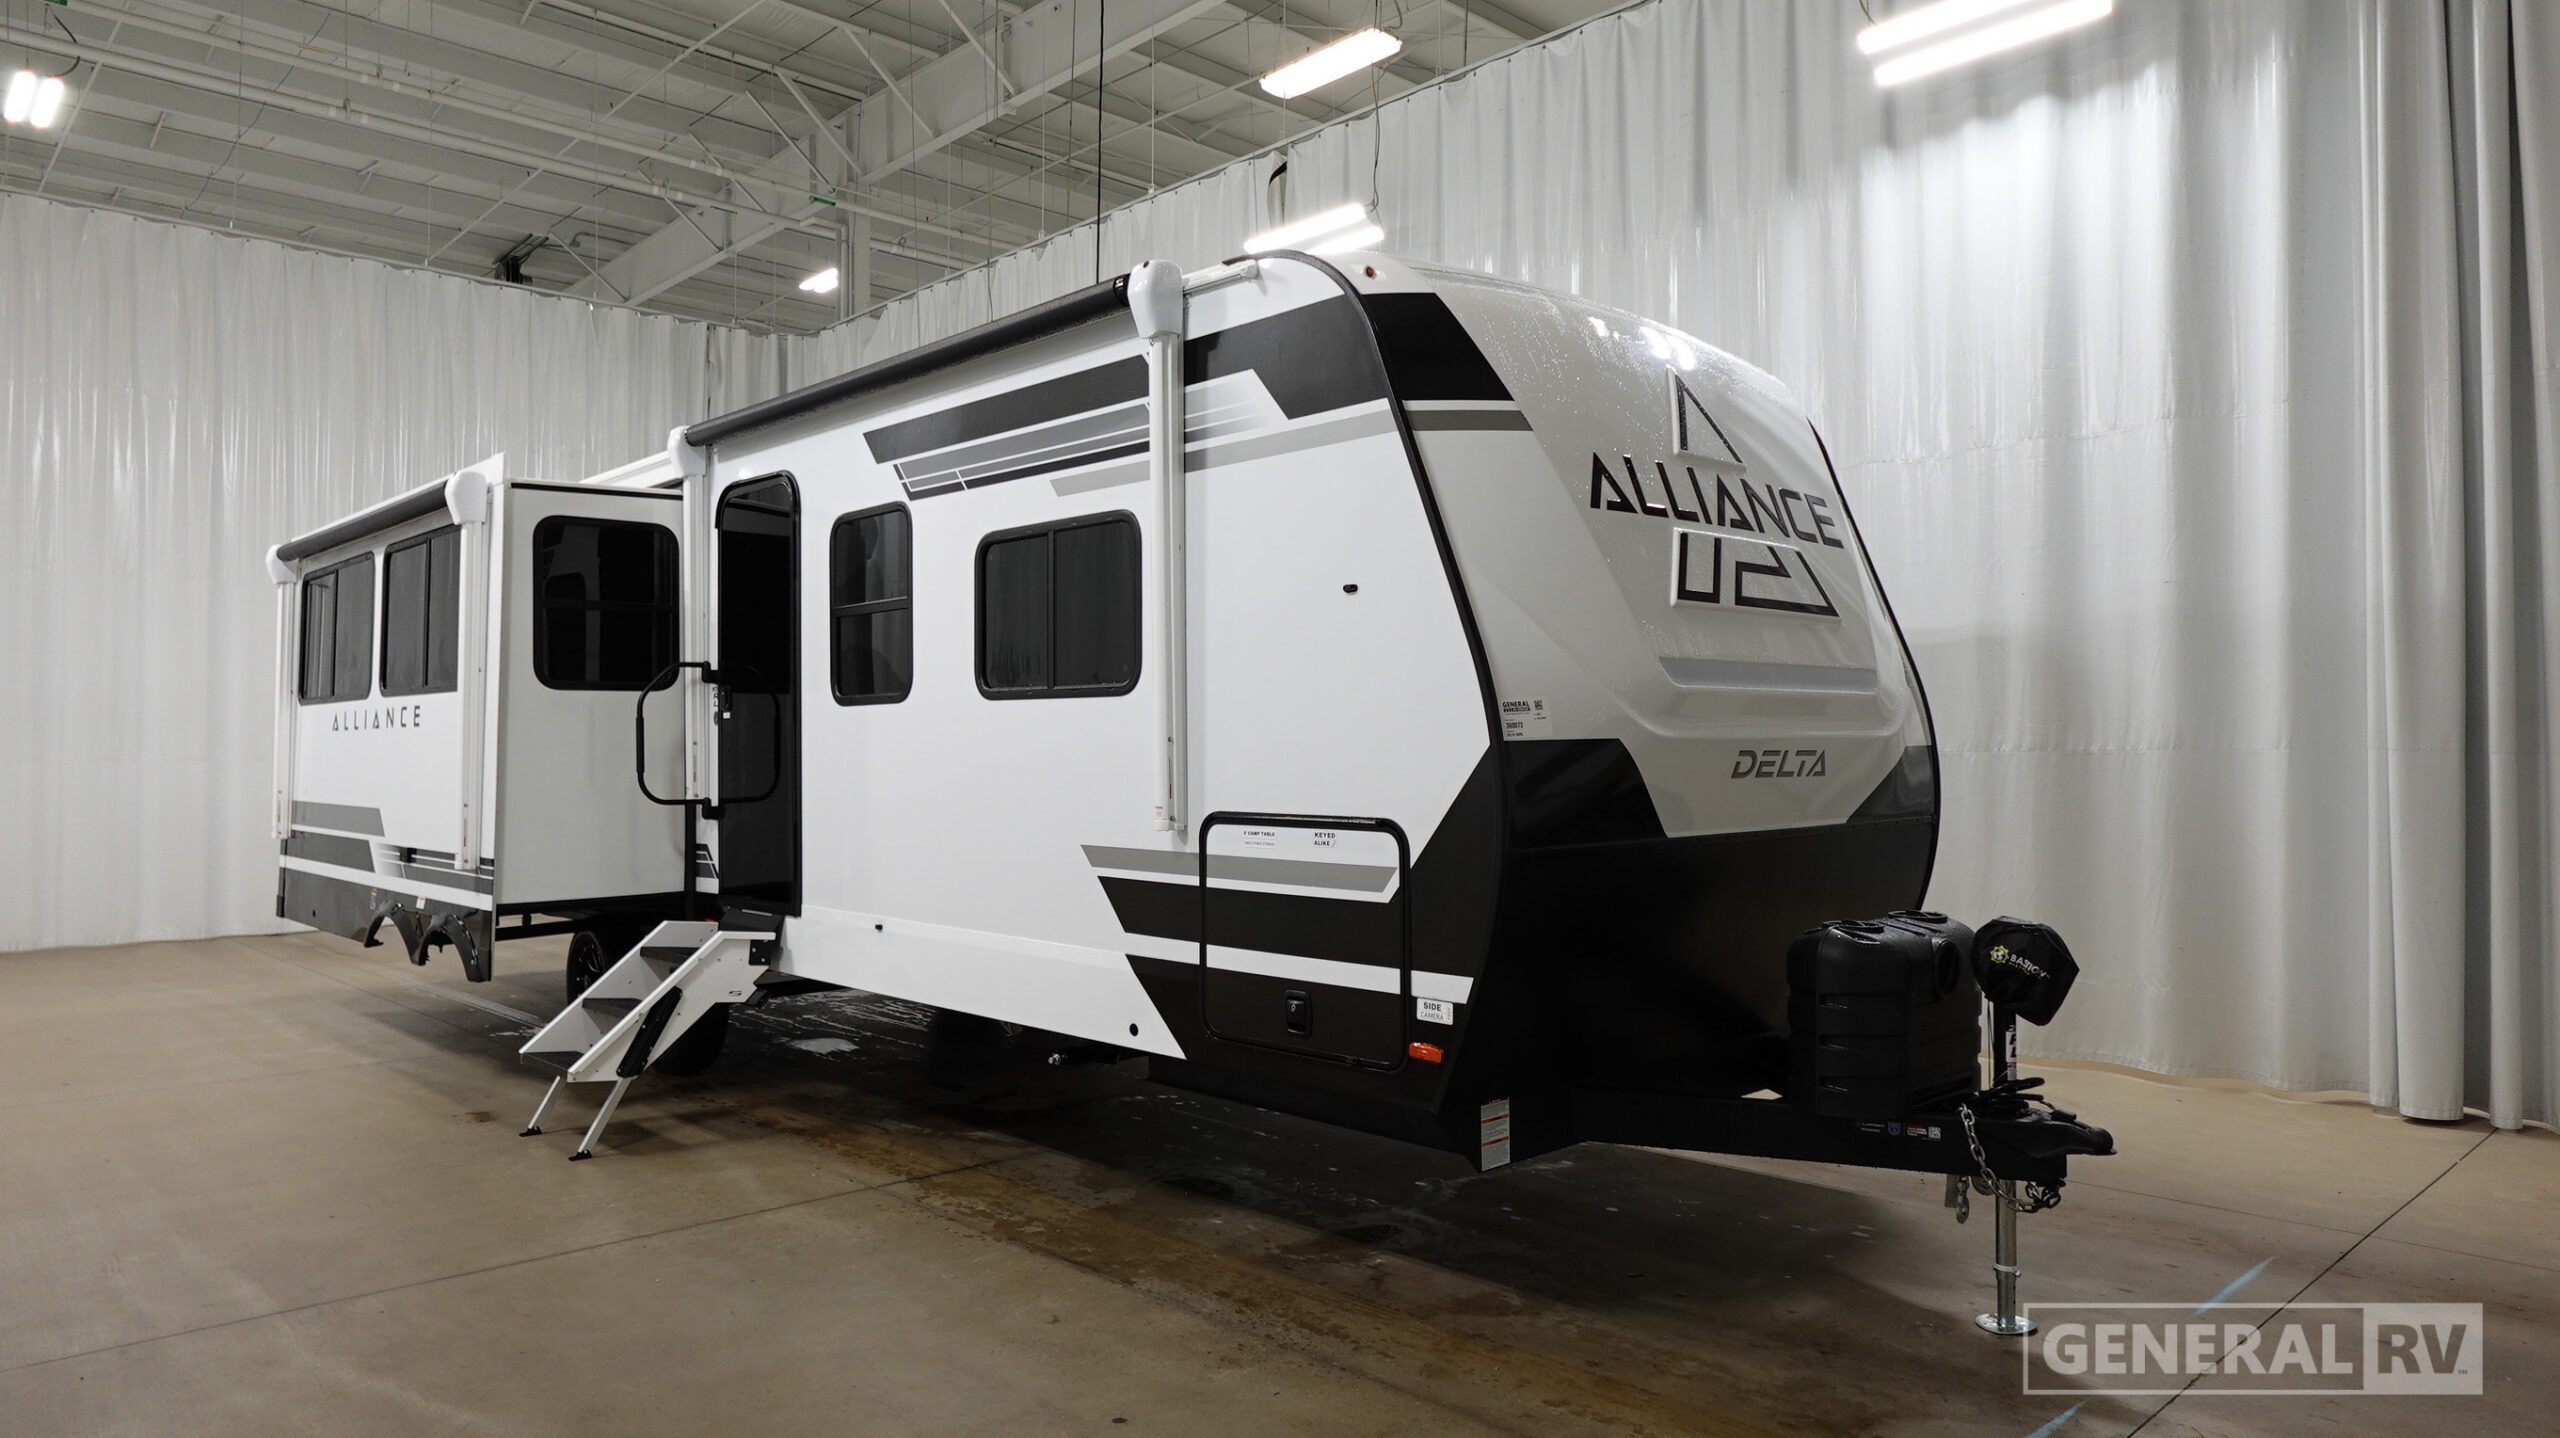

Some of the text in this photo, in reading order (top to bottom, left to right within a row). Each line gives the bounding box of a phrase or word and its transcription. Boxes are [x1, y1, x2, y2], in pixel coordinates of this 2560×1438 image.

[1589, 451, 1844, 549] ALLIANCE
[332, 705, 422, 732] ALLIANCE
[1731, 749, 1827, 780] DELTA
[1314, 831, 1336, 839] KEYED
[1420, 1011, 1444, 1021] CAMERA
[1423, 1001, 1442, 1012] SIDE
